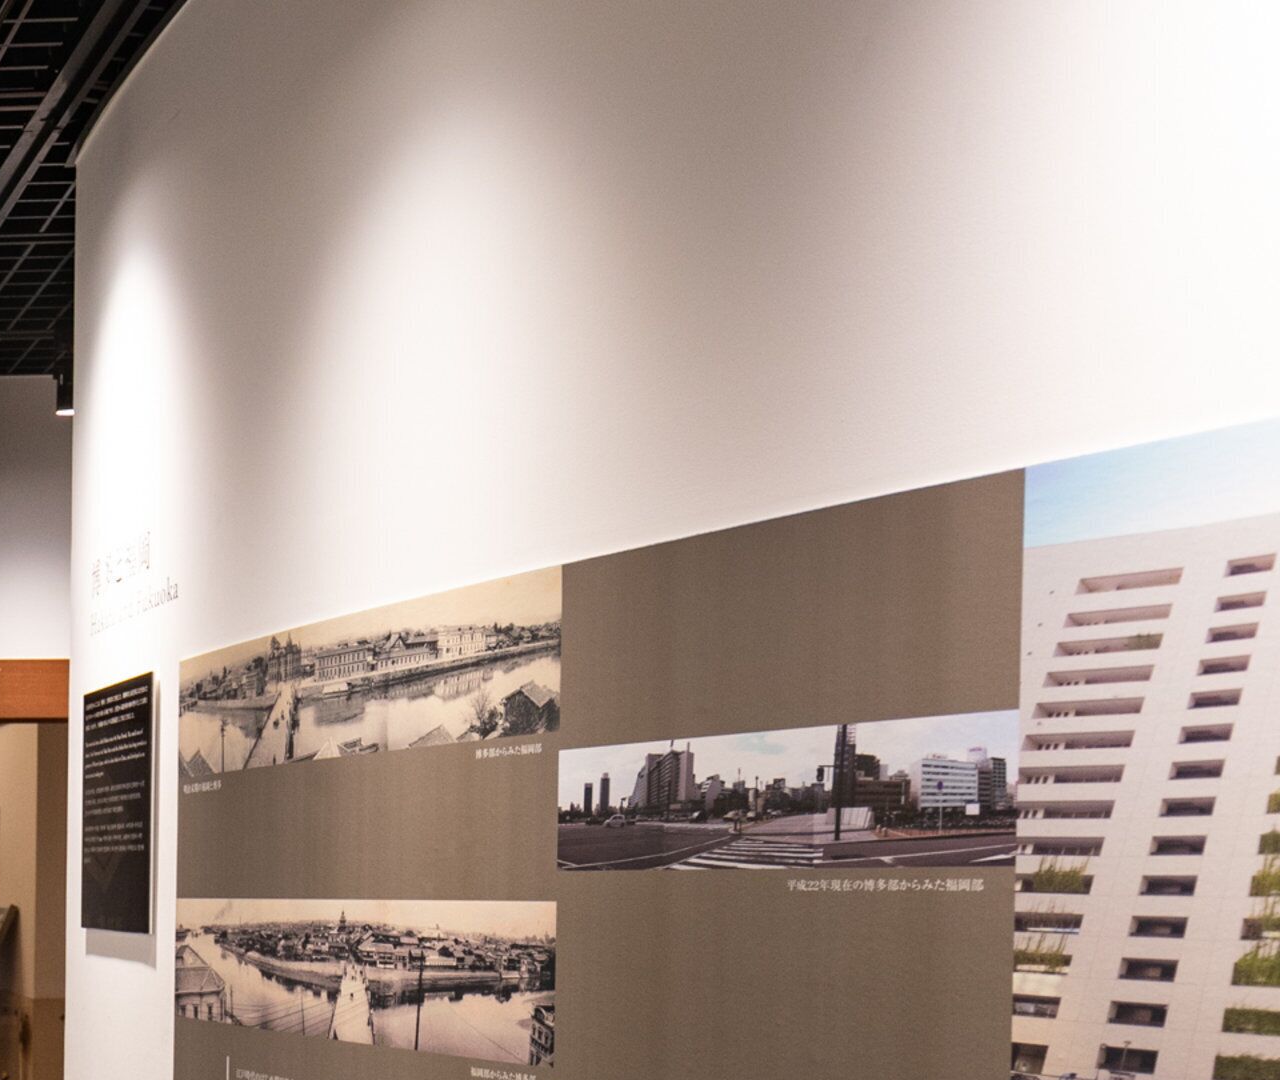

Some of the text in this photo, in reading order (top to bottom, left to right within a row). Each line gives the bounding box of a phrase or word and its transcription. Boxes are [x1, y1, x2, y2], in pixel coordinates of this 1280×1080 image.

[786, 878, 985, 894] 平成22年現在の博多部からみた福岡部
